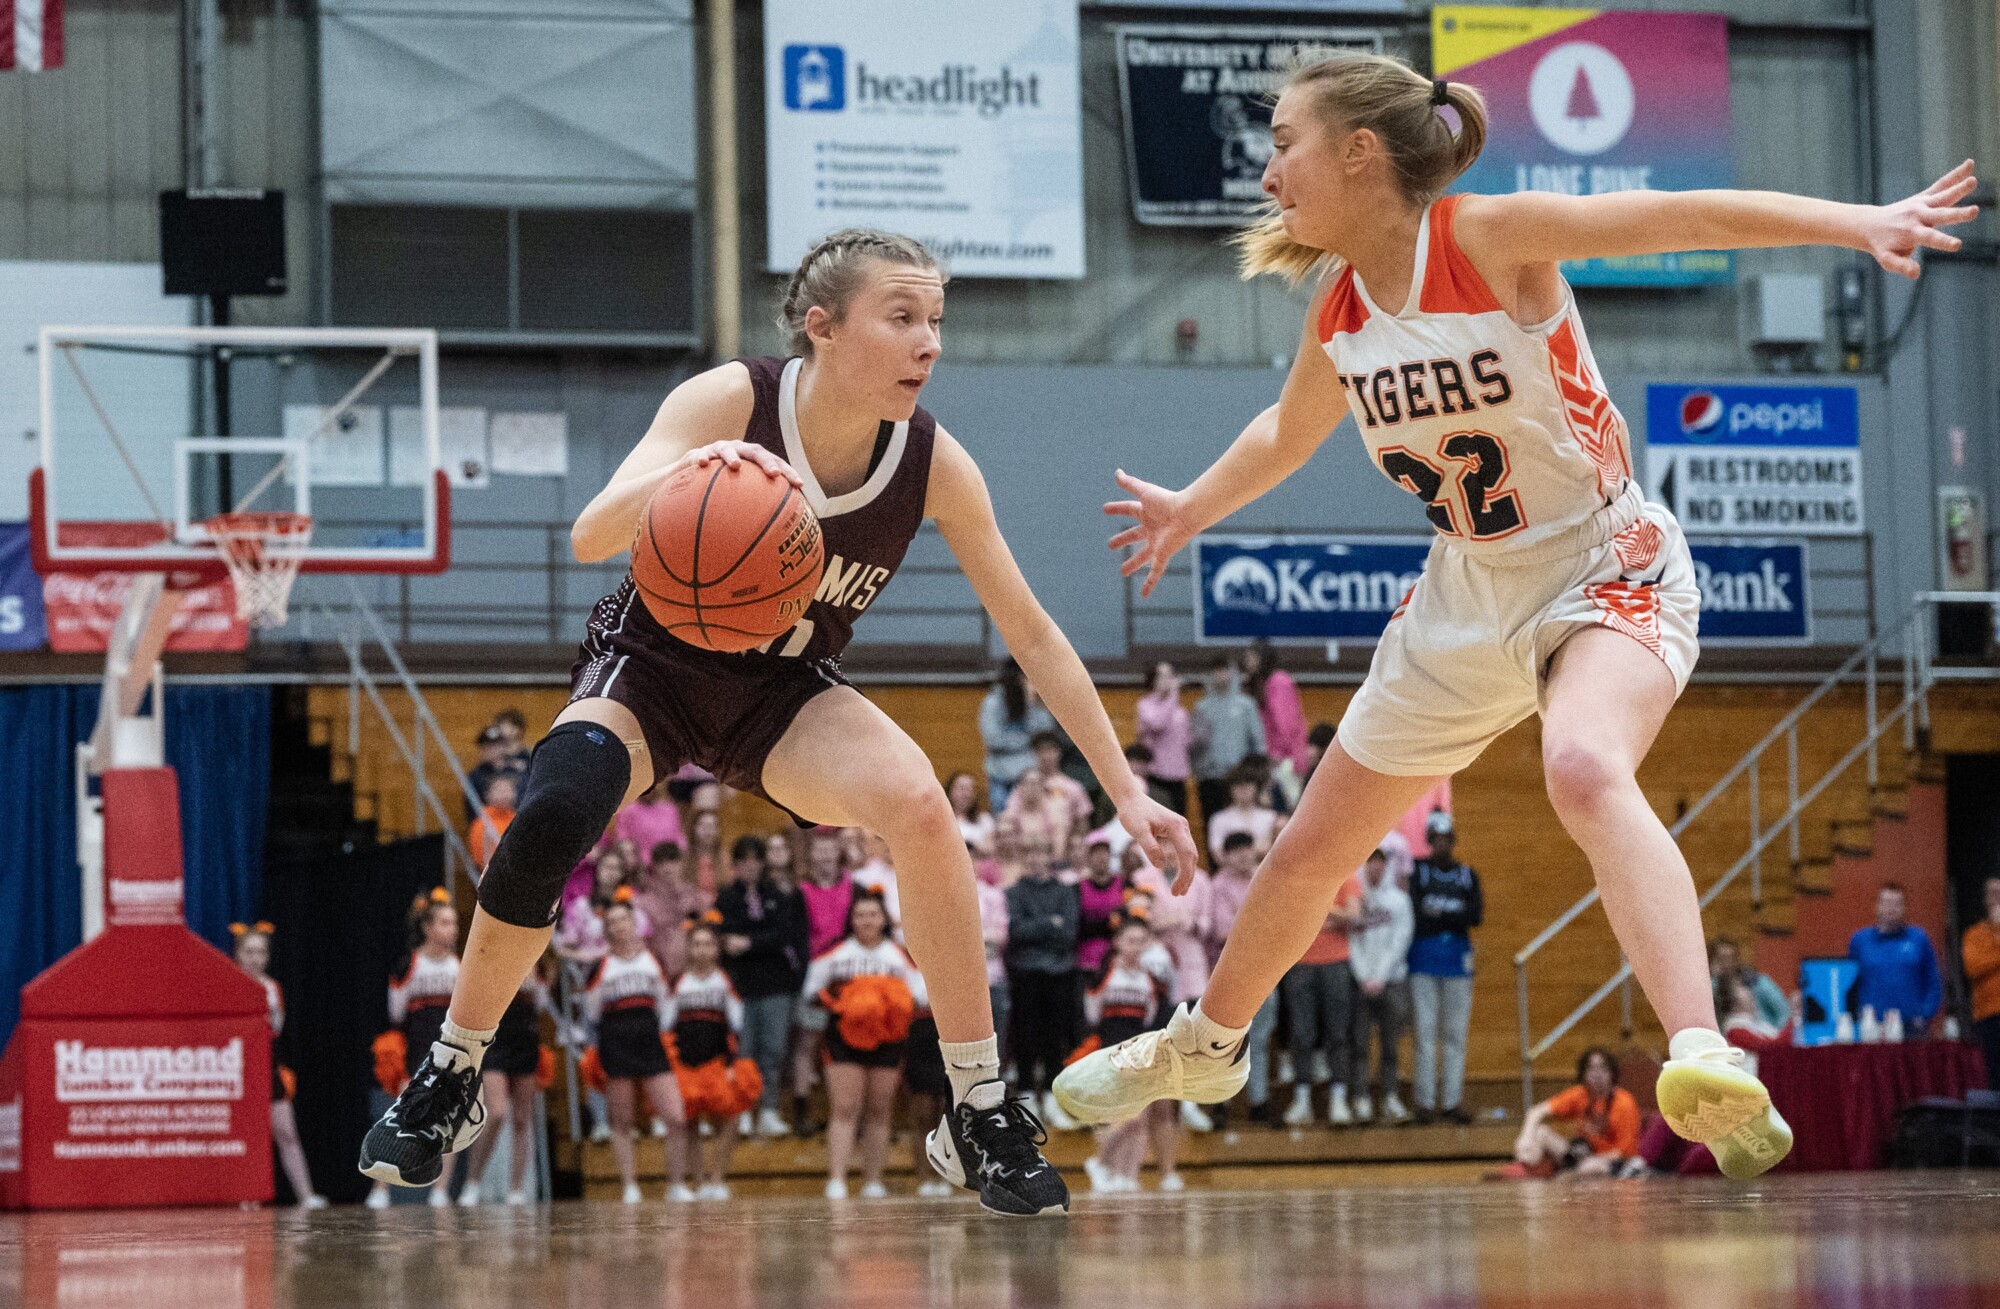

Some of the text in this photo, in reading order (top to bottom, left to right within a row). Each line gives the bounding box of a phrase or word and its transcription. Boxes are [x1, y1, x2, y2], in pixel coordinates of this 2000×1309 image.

[857, 62, 1041, 119] headlight
[1729, 397, 1824, 438] pepsi
[1377, 429, 1530, 543] 22
[1688, 457, 1854, 484] RESTROOMS
[1688, 497, 1859, 524] NO SMOKING
[1693, 557, 1794, 612] Bank
[54, 1036, 244, 1074] Hammond
[142, 1073, 236, 1097] Company
